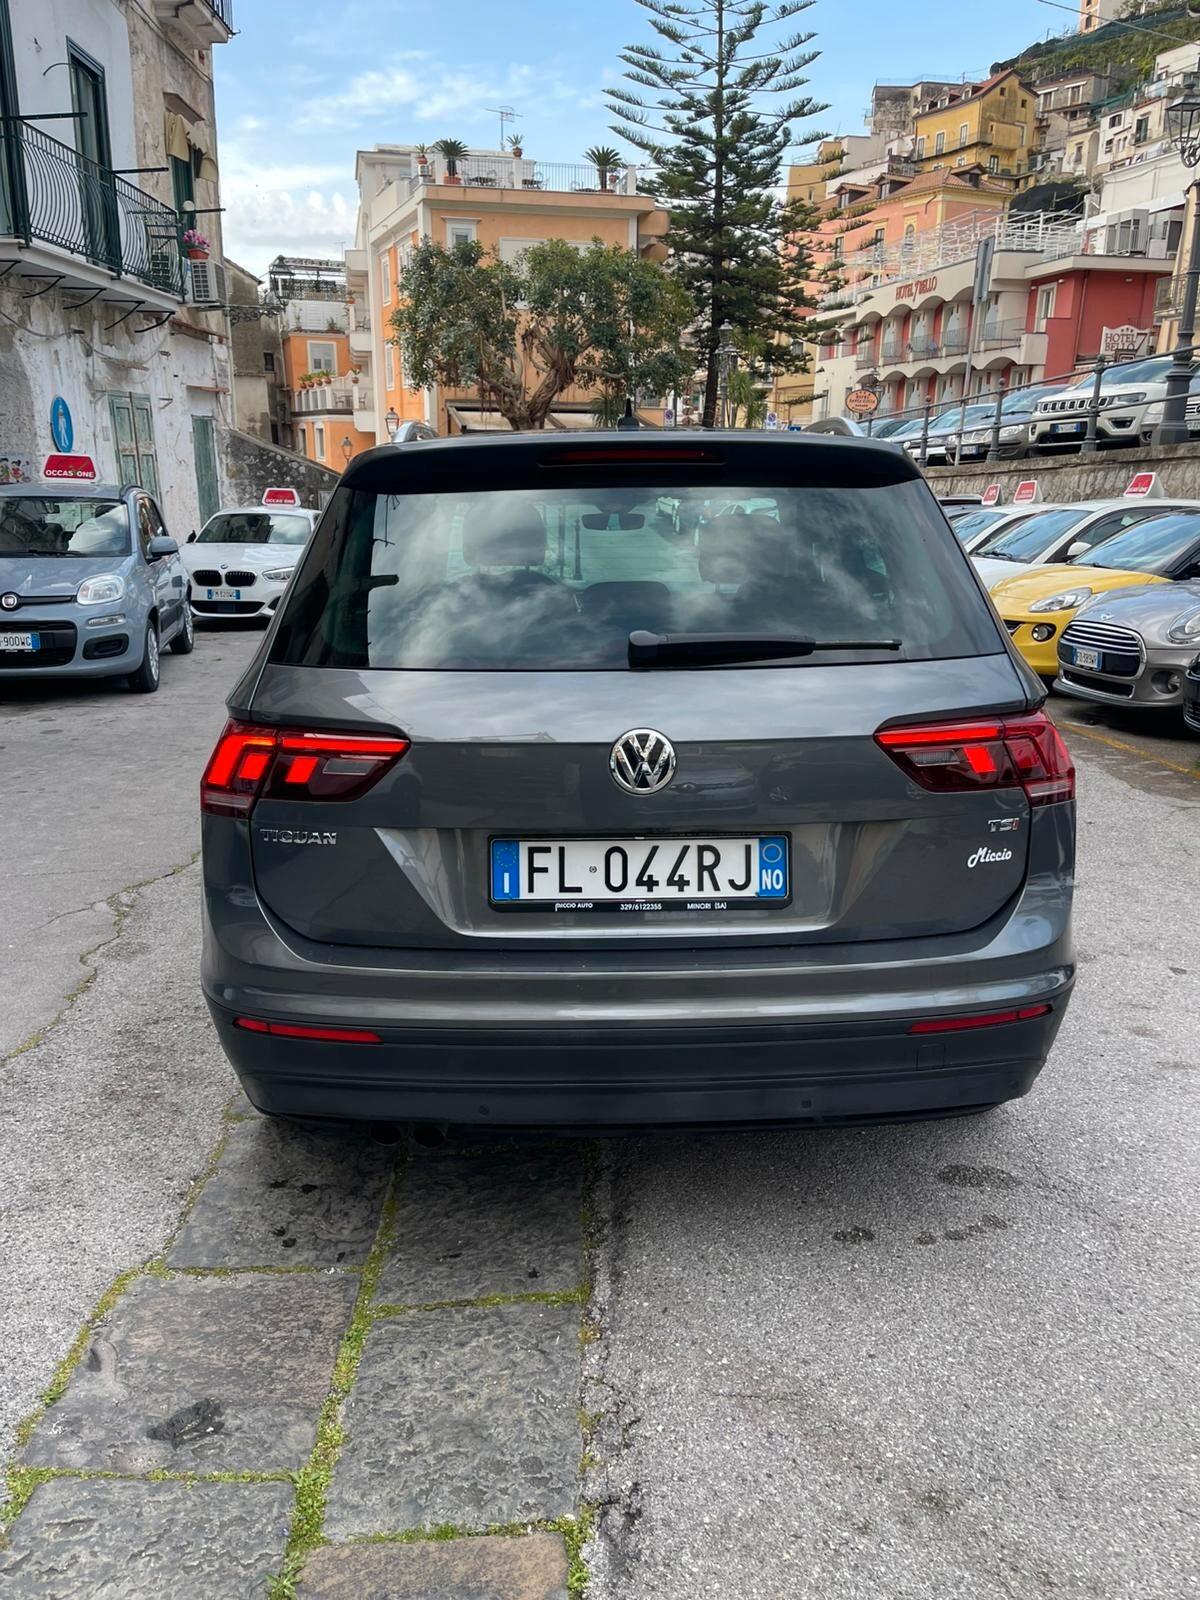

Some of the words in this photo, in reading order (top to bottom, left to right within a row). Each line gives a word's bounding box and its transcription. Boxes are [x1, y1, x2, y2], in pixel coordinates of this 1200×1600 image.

[1104, 332, 1136, 343] HOTEL
[1135, 332, 1148, 353] 7
[1104, 342, 1136, 351] BELLO
[45, 469, 95, 478] OCCASONE
[987, 817, 1020, 833] TSI
[259, 828, 337, 845] TIGUAN
[967, 846, 1013, 869] Miccio
[761, 869, 783, 890] NO
[620, 903, 662, 911] 329/6122355
[687, 902, 712, 910] MINORI
[714, 901, 728, 910] (SA)
